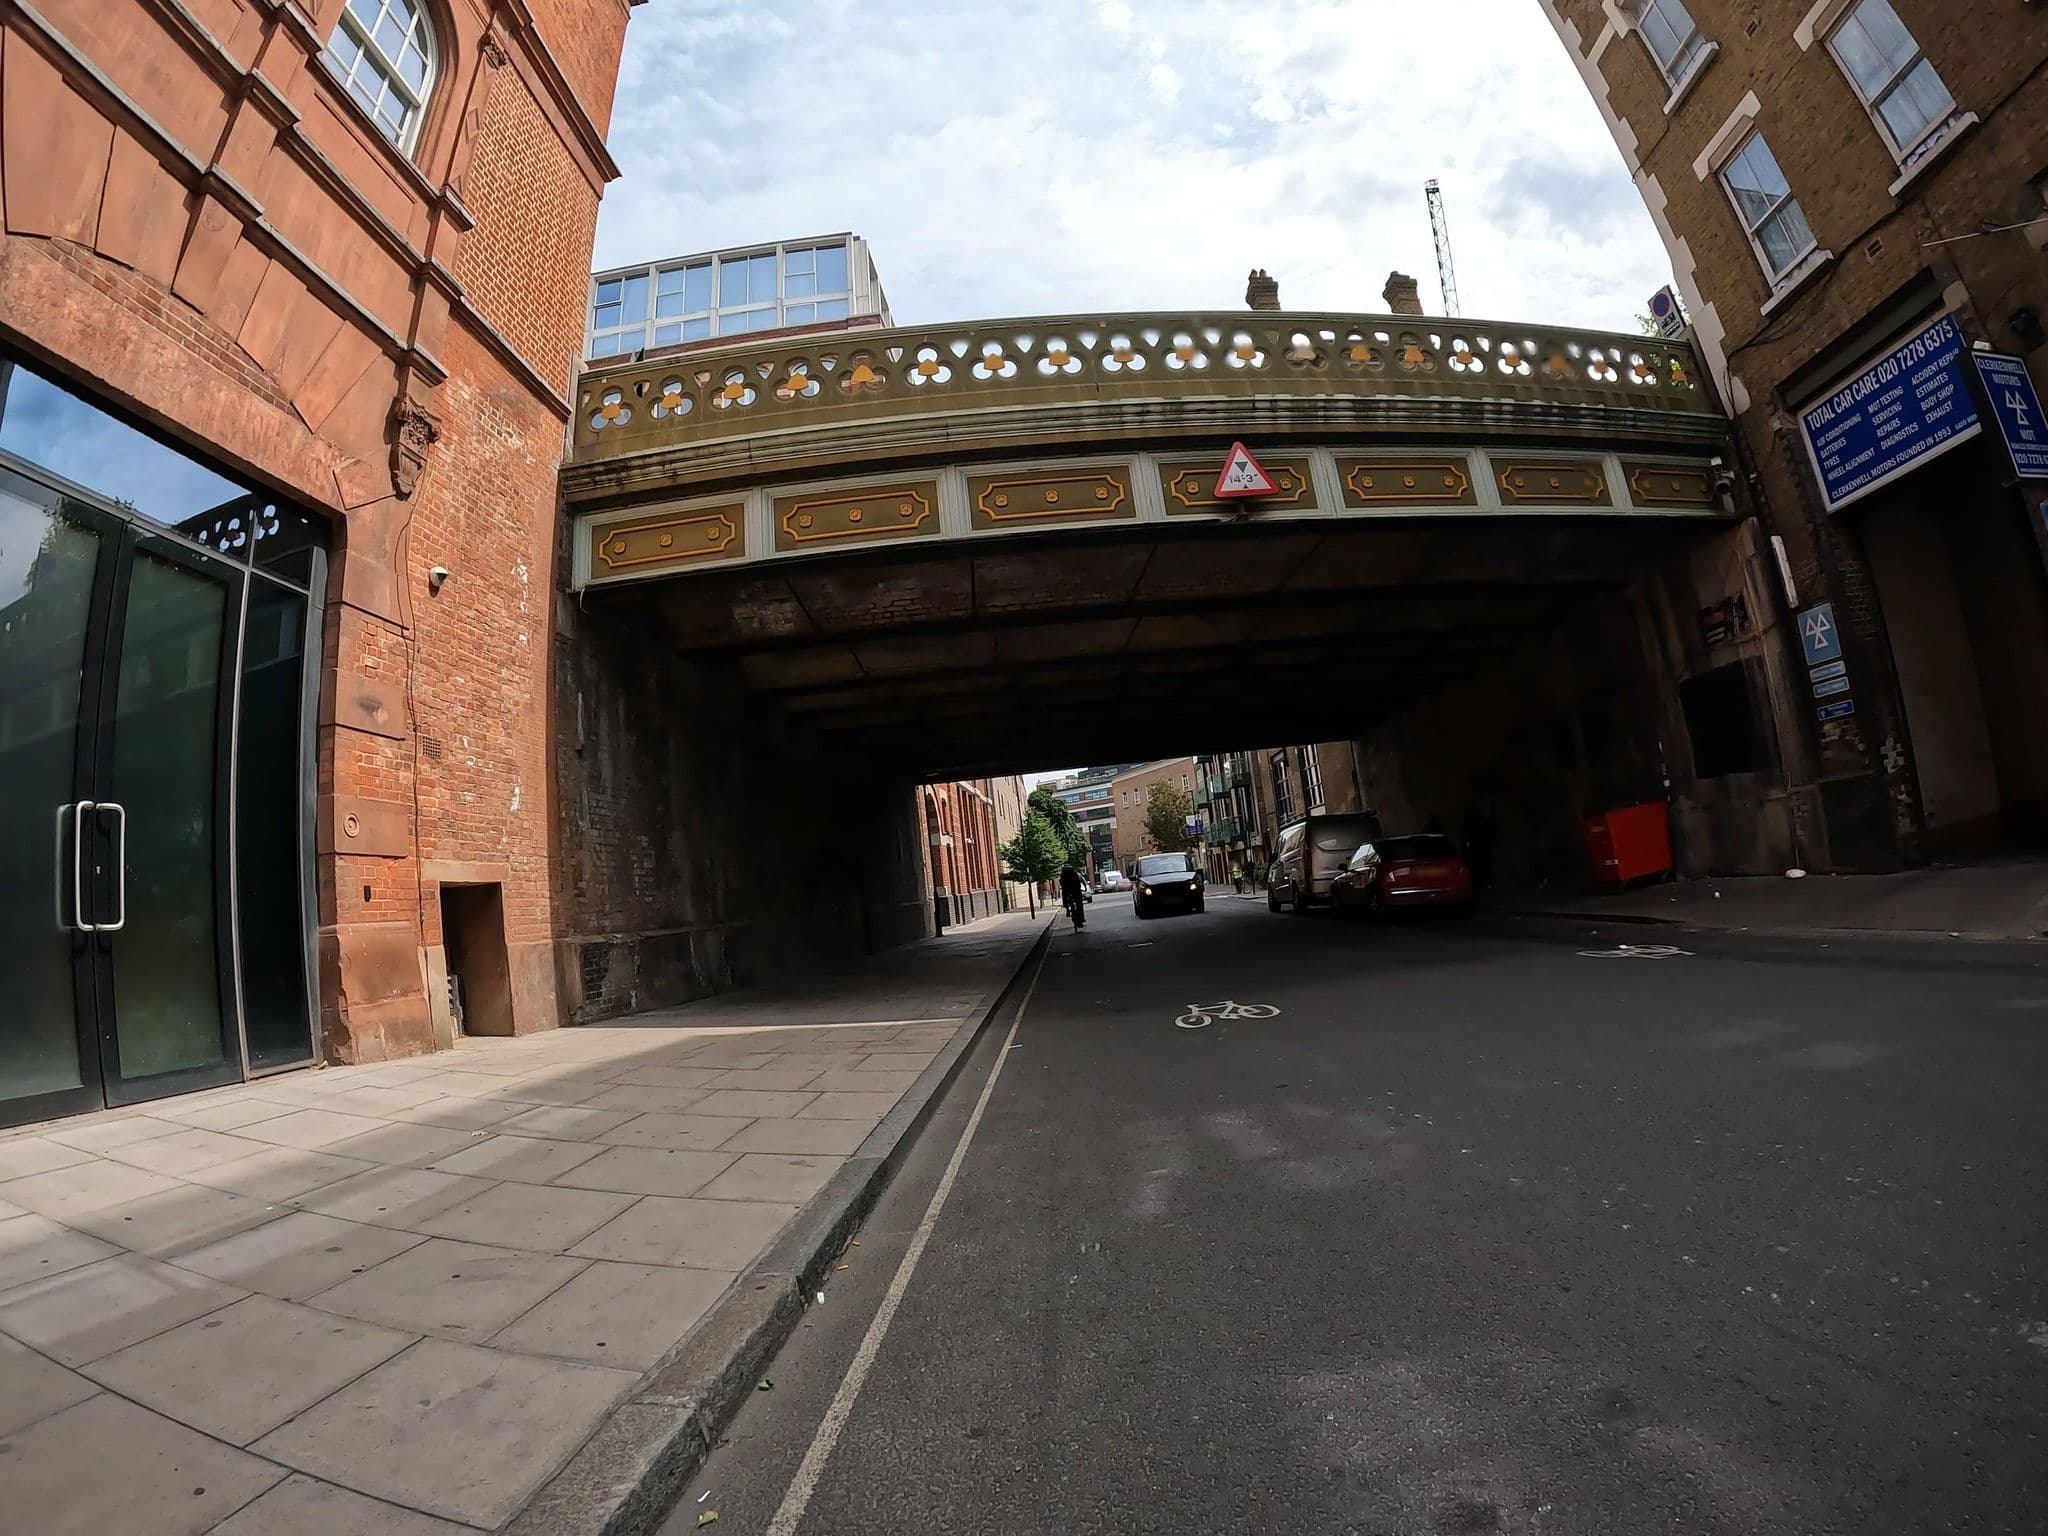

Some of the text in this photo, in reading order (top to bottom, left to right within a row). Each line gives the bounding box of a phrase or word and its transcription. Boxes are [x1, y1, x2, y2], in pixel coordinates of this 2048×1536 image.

[1807, 319, 1954, 431] TOTAL CAR CARE 020 7278 6375
[1911, 361, 1939, 386] ACCIDENT
[1976, 357, 2025, 374] CLERKENWELL
[1915, 371, 1949, 398] ESTIMATES
[1992, 372, 2021, 387] MOTORS
[1867, 385, 1904, 414] MOT TESTING
[1920, 383, 1955, 411] BODY SHOP
[1871, 401, 1903, 426] SERVICING
[1924, 400, 1953, 424] EXHAUST
[1816, 412, 1862, 448] AIR CONDITIONING
[1875, 417, 1902, 439] REPAIRS
[1880, 421, 1920, 450] DIAGNOSTICS
[1820, 436, 1848, 459] BATTERIES
[1823, 454, 1841, 470] TYRES
[1827, 447, 1876, 481] WHEEL ALIGNMENT
[1831, 426, 1952, 500] CLERKENWELL MOTORS FOUNDED IN 1993
